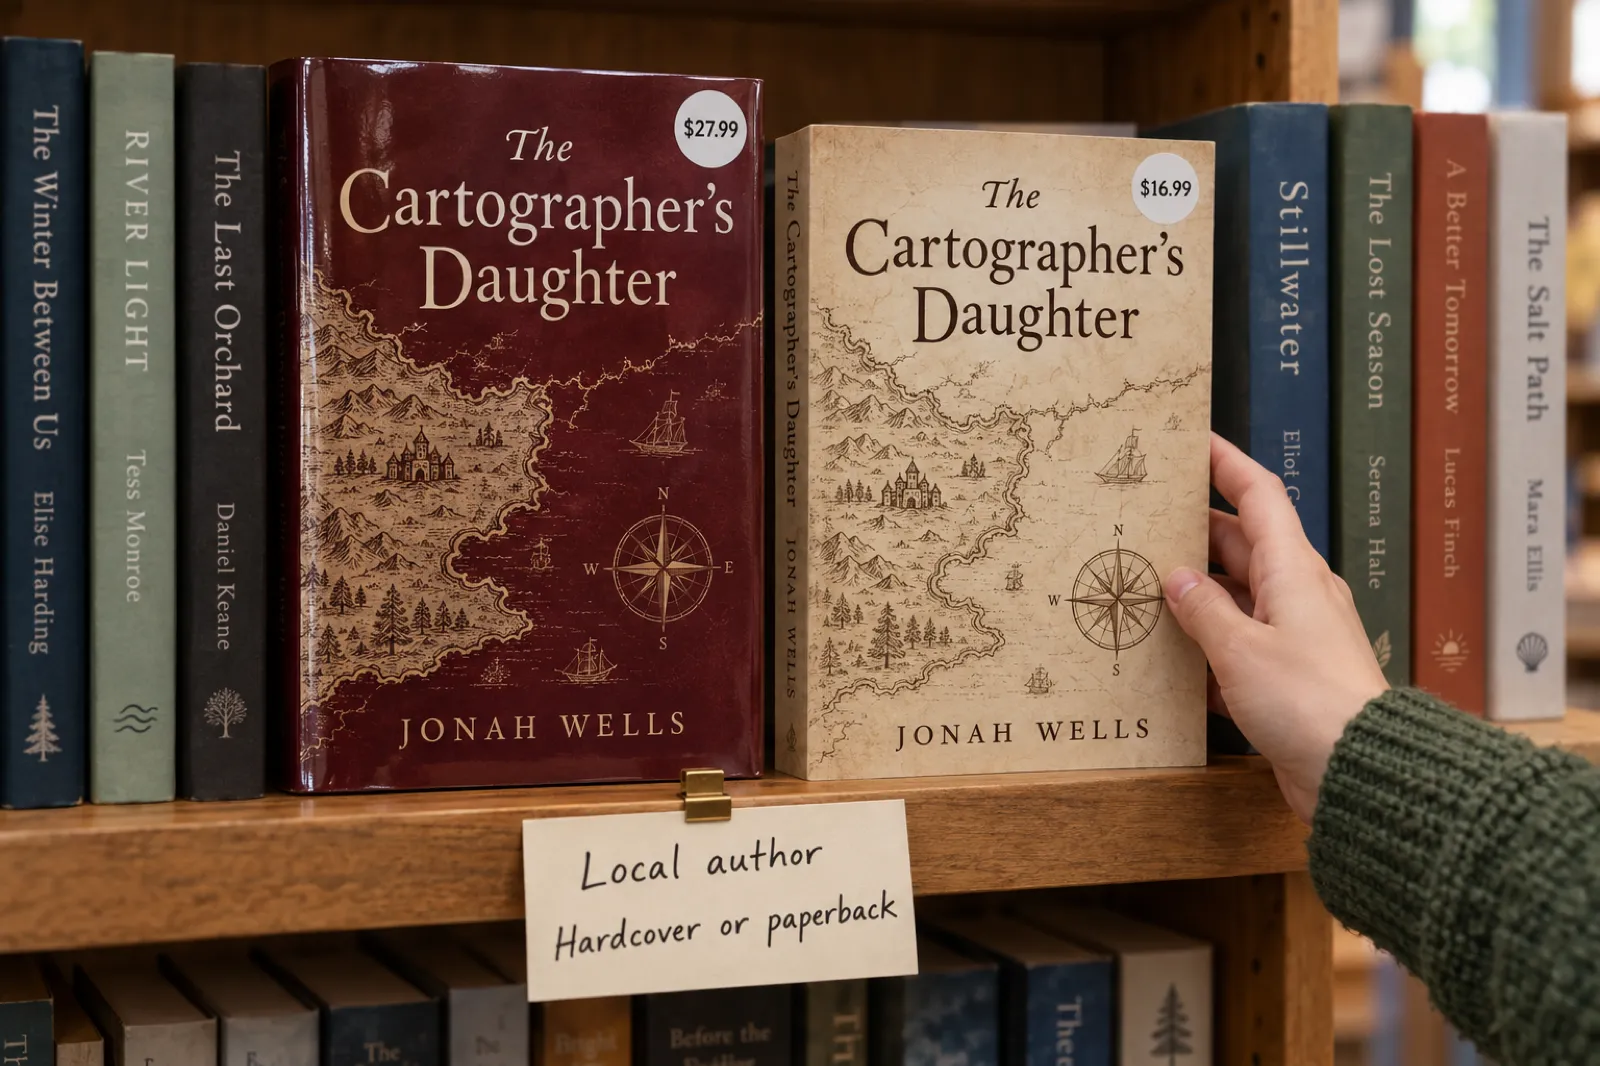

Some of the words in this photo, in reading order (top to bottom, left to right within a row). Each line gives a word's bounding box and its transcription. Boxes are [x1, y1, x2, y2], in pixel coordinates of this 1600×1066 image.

[32, 105, 60, 161] The
[505, 125, 573, 162] The
[683, 118, 739, 140] $27.99
[125, 130, 149, 243] RIVER
[214, 150, 241, 208] The
[786, 170, 799, 211] The
[981, 177, 1041, 209] The
[1140, 180, 1192, 198] $16.99
[1446, 159, 1467, 179] A
[32, 171, 59, 269] Winter
[339, 167, 734, 250] Cartographer’s
[1368, 173, 1392, 226] The
[214, 222, 241, 291] Last
[845, 218, 1184, 288] Cartographer’s
[1446, 192, 1467, 270] Better
[1527, 215, 1550, 272] The
[419, 246, 677, 322] Daughter
[1279, 181, 1309, 376] Stillwater
[1368, 238, 1392, 299] Lost
[32, 280, 58, 401] Between
[125, 260, 149, 372] LIGHT
[912, 286, 1140, 352] Daughter
[1527, 285, 1550, 342] Salt
[214, 304, 241, 433] Orchard
[1368, 311, 1392, 410] Season
[1445, 279, 1467, 415] Tomorrow
[1527, 355, 1550, 422] Path
[32, 412, 59, 451] Us
[783, 399, 801, 508] Daughter
[1283, 429, 1301, 478] Eliot
[126, 449, 146, 500] Tess
[657, 486, 670, 500] N
[1368, 455, 1386, 528] Serena
[1444, 447, 1460, 509] Lucas
[33, 491, 54, 547] Elise
[1112, 523, 1124, 536] N
[1527, 479, 1544, 536] Mara
[126, 510, 146, 603] Monroe
[216, 502, 235, 575] Daniel
[724, 560, 734, 574] E
[1368, 538, 1386, 590] Hale
[1444, 518, 1460, 579] Finch
[583, 562, 600, 576] W
[786, 537, 797, 614] JONAH
[1527, 545, 1544, 592] Ellis
[28, 557, 54, 655] Harding
[216, 583, 235, 651] Keane
[1047, 594, 1062, 606] W
[659, 636, 668, 650] S
[786, 626, 797, 699] WELLS
[1112, 663, 1121, 677] S
[399, 715, 537, 750] JONAH
[559, 711, 686, 739] WELLS
[895, 723, 1013, 752] JONAH
[1036, 718, 1150, 742] WELLS
[581, 843, 680, 890] Local
[707, 837, 823, 875] author
[555, 918, 701, 961] Hardcover
[720, 916, 750, 936] or
[768, 890, 898, 947] paperback
[363, 1040, 401, 1063] The
[669, 1025, 733, 1049] Before
[740, 1021, 772, 1044] the
